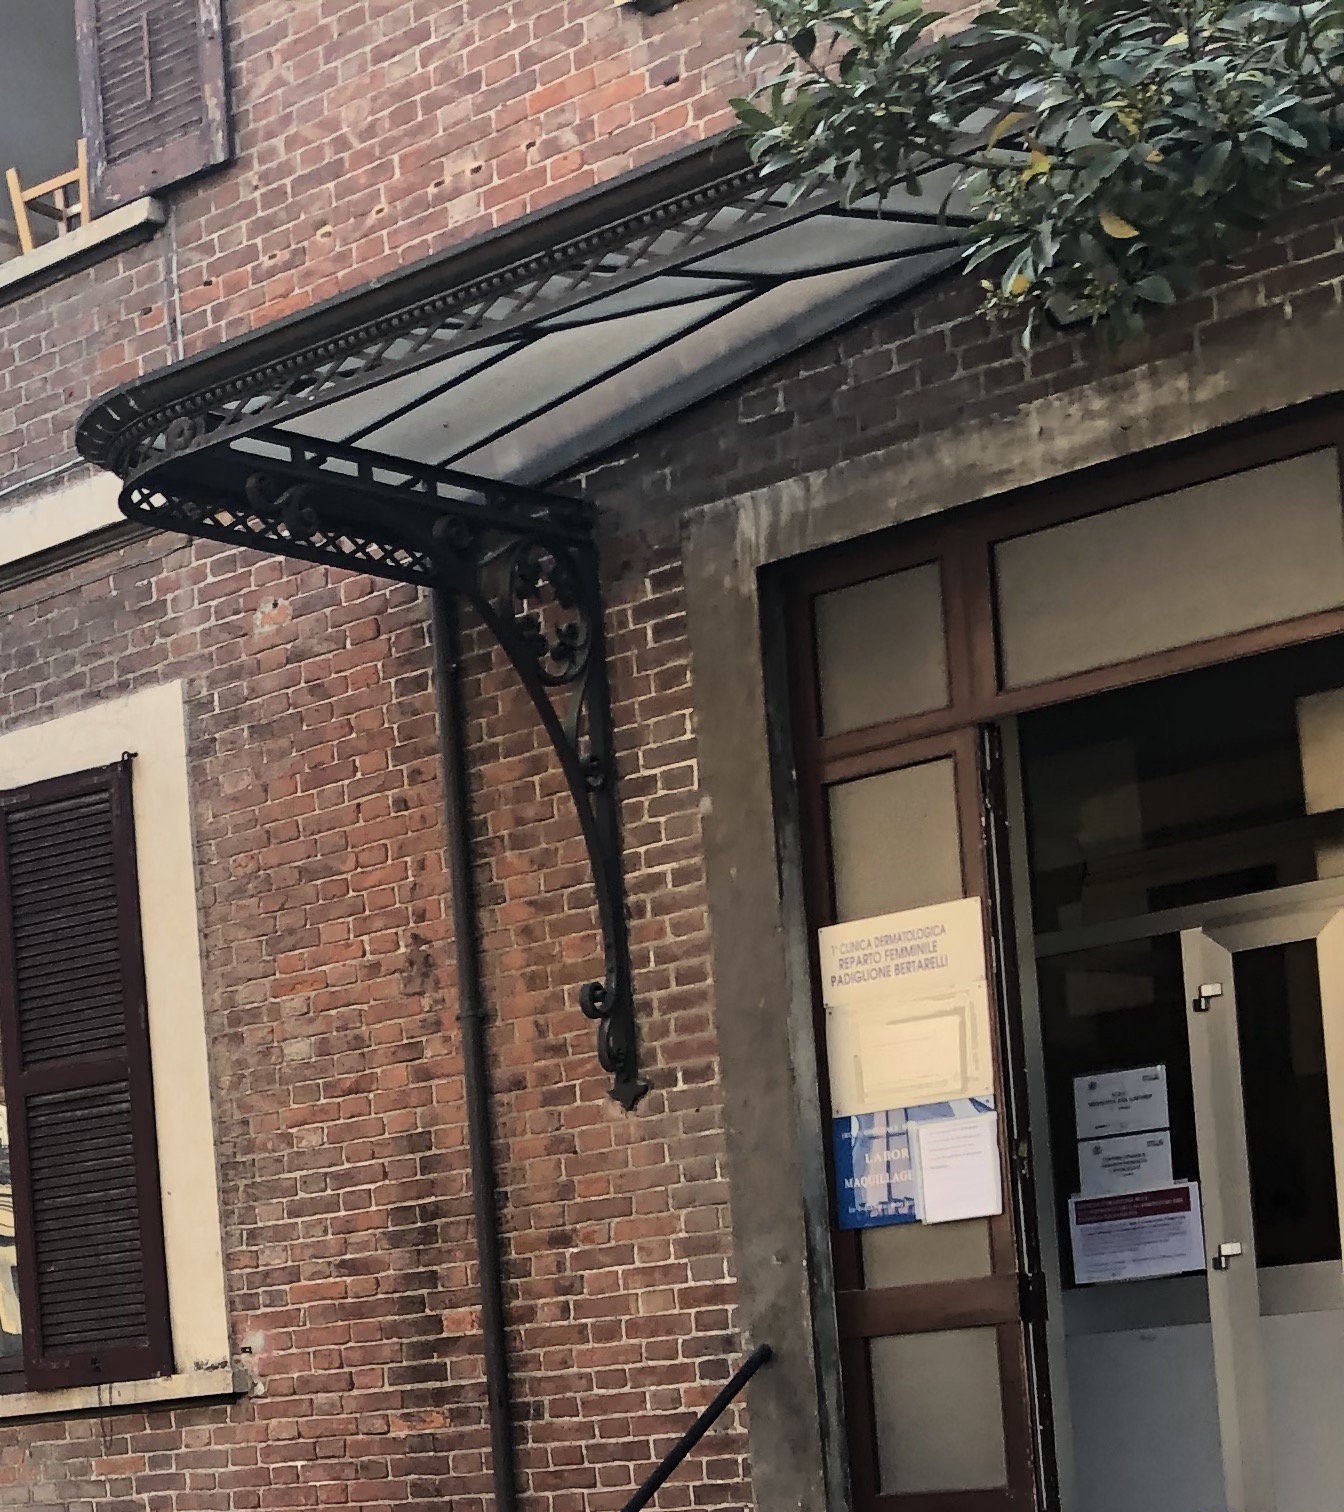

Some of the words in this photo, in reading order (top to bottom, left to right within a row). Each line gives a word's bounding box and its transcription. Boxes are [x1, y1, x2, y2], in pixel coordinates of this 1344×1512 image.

[840, 939, 872, 954] CLINICA
[874, 924, 946, 948] DERMATOLOGICA
[838, 952, 882, 970] REPARTO
[884, 940, 938, 962] FEMMINILE
[830, 965, 892, 987] PADIGLIONE
[894, 954, 949, 976] BERTARELLI
